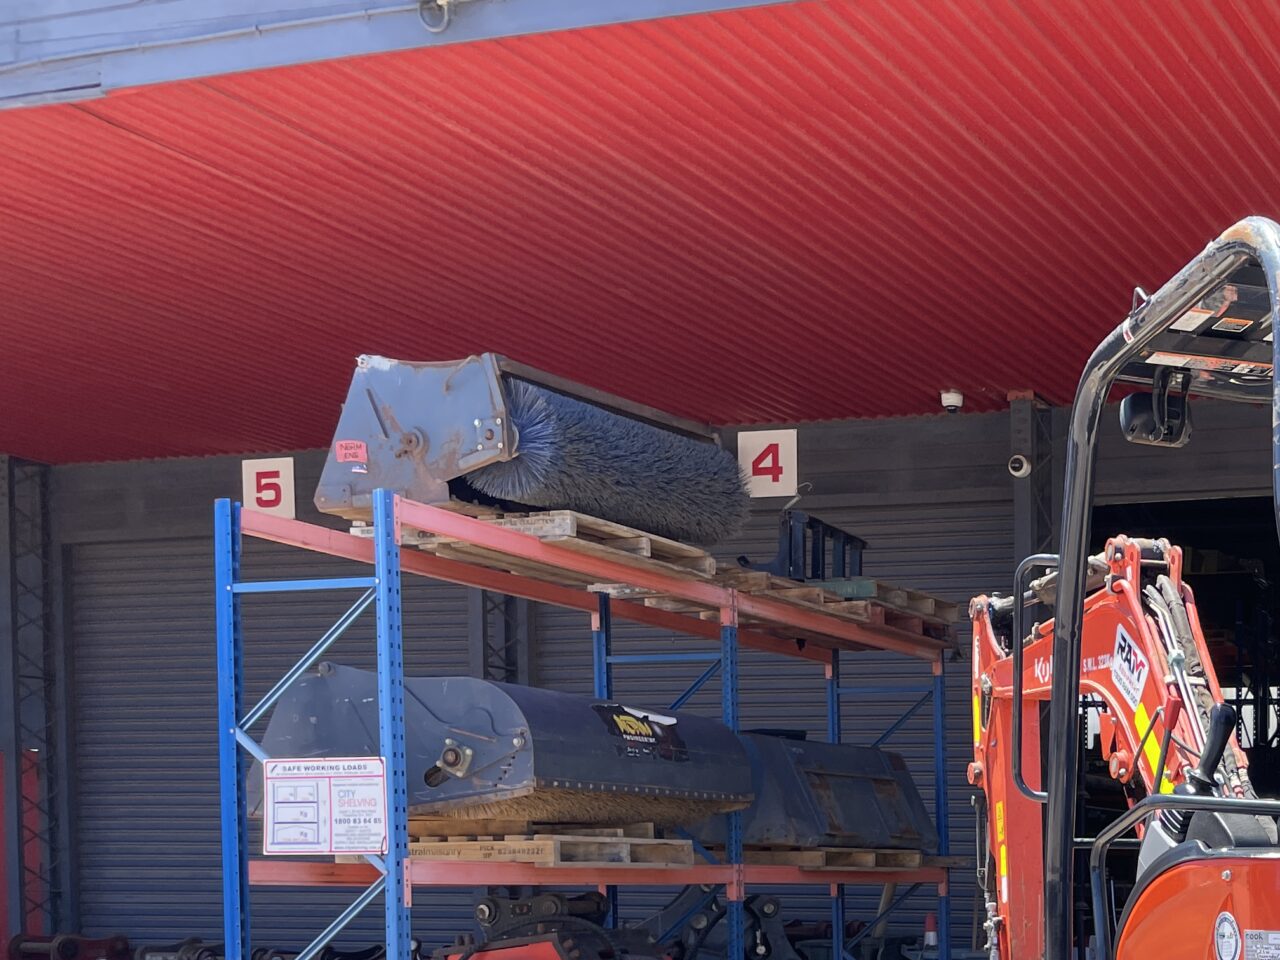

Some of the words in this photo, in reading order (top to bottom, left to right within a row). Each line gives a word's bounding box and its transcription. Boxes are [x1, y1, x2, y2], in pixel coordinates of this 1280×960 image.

[752, 443, 783, 482] 4
[255, 470, 282, 508] 5
[1117, 633, 1146, 682] RAM
[337, 789, 356, 799] CITY
[338, 798, 377, 807] SHELVING
